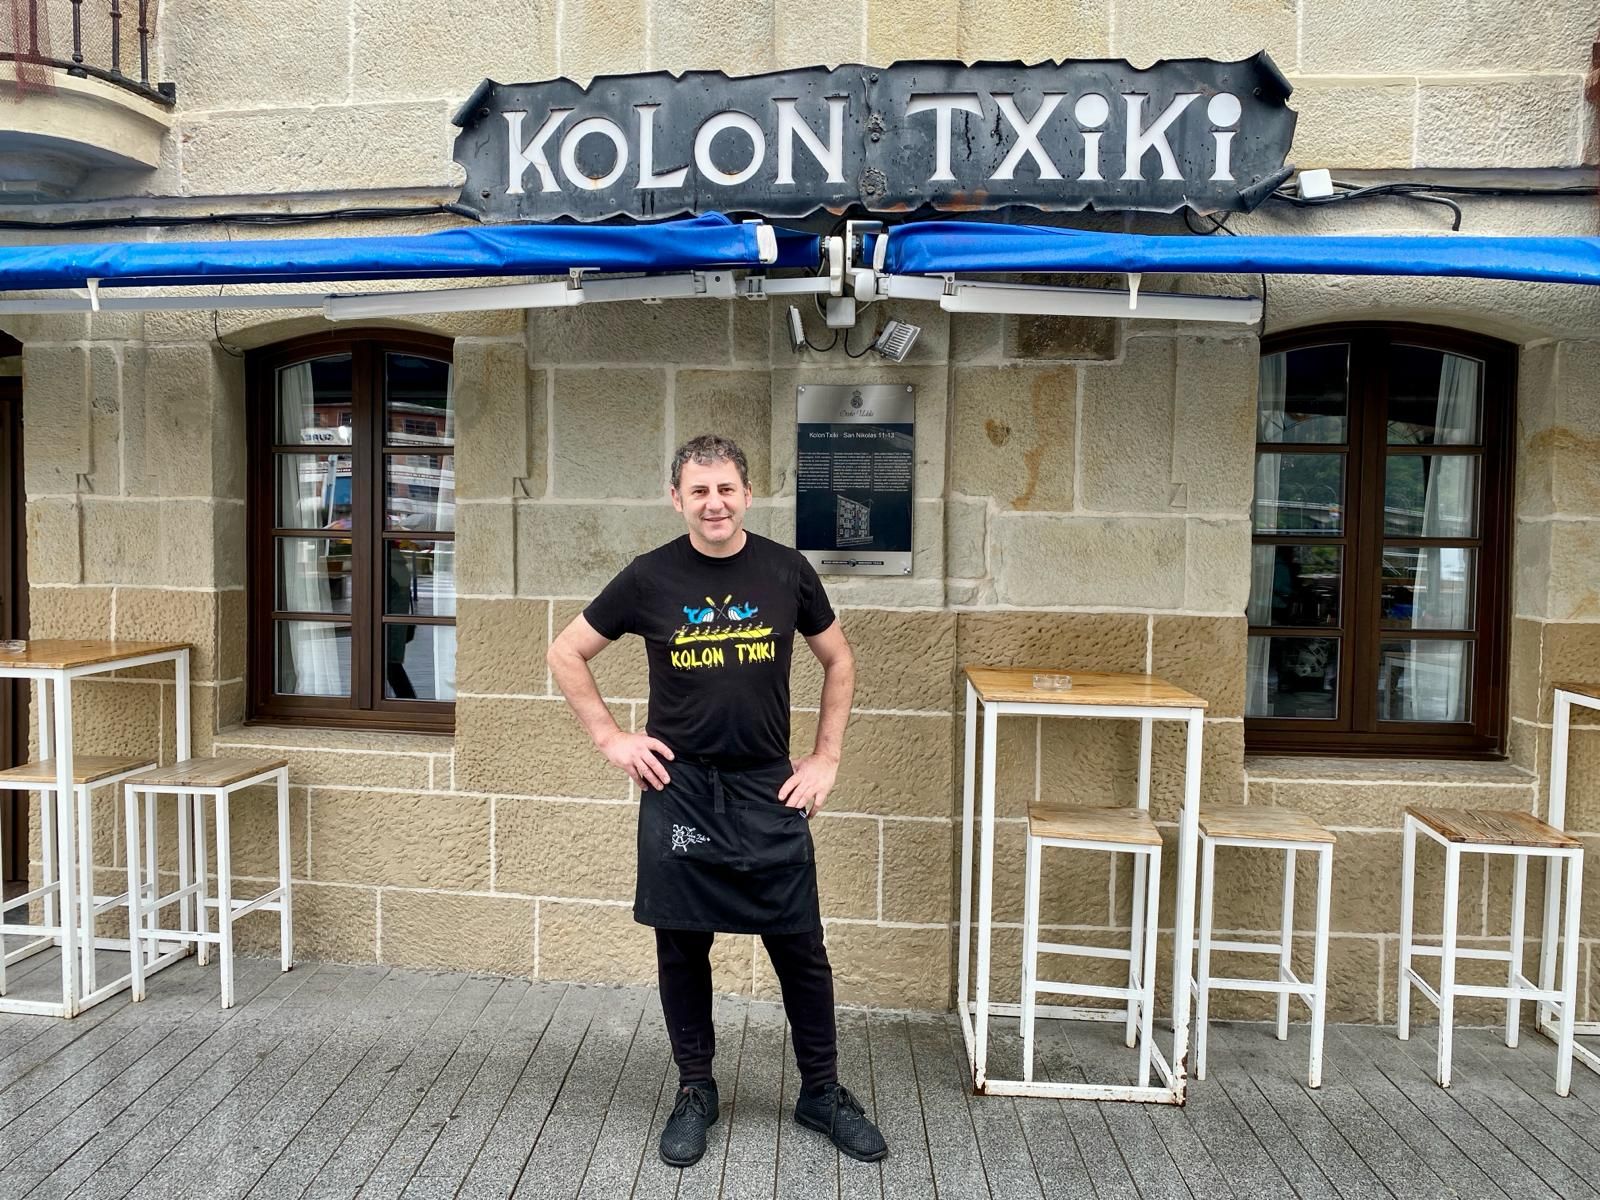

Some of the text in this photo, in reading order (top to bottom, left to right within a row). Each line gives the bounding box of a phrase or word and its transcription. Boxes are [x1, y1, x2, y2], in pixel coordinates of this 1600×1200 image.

[503, 96, 849, 196] KOLON
[670, 641, 776, 670] KOLON TXIKI
